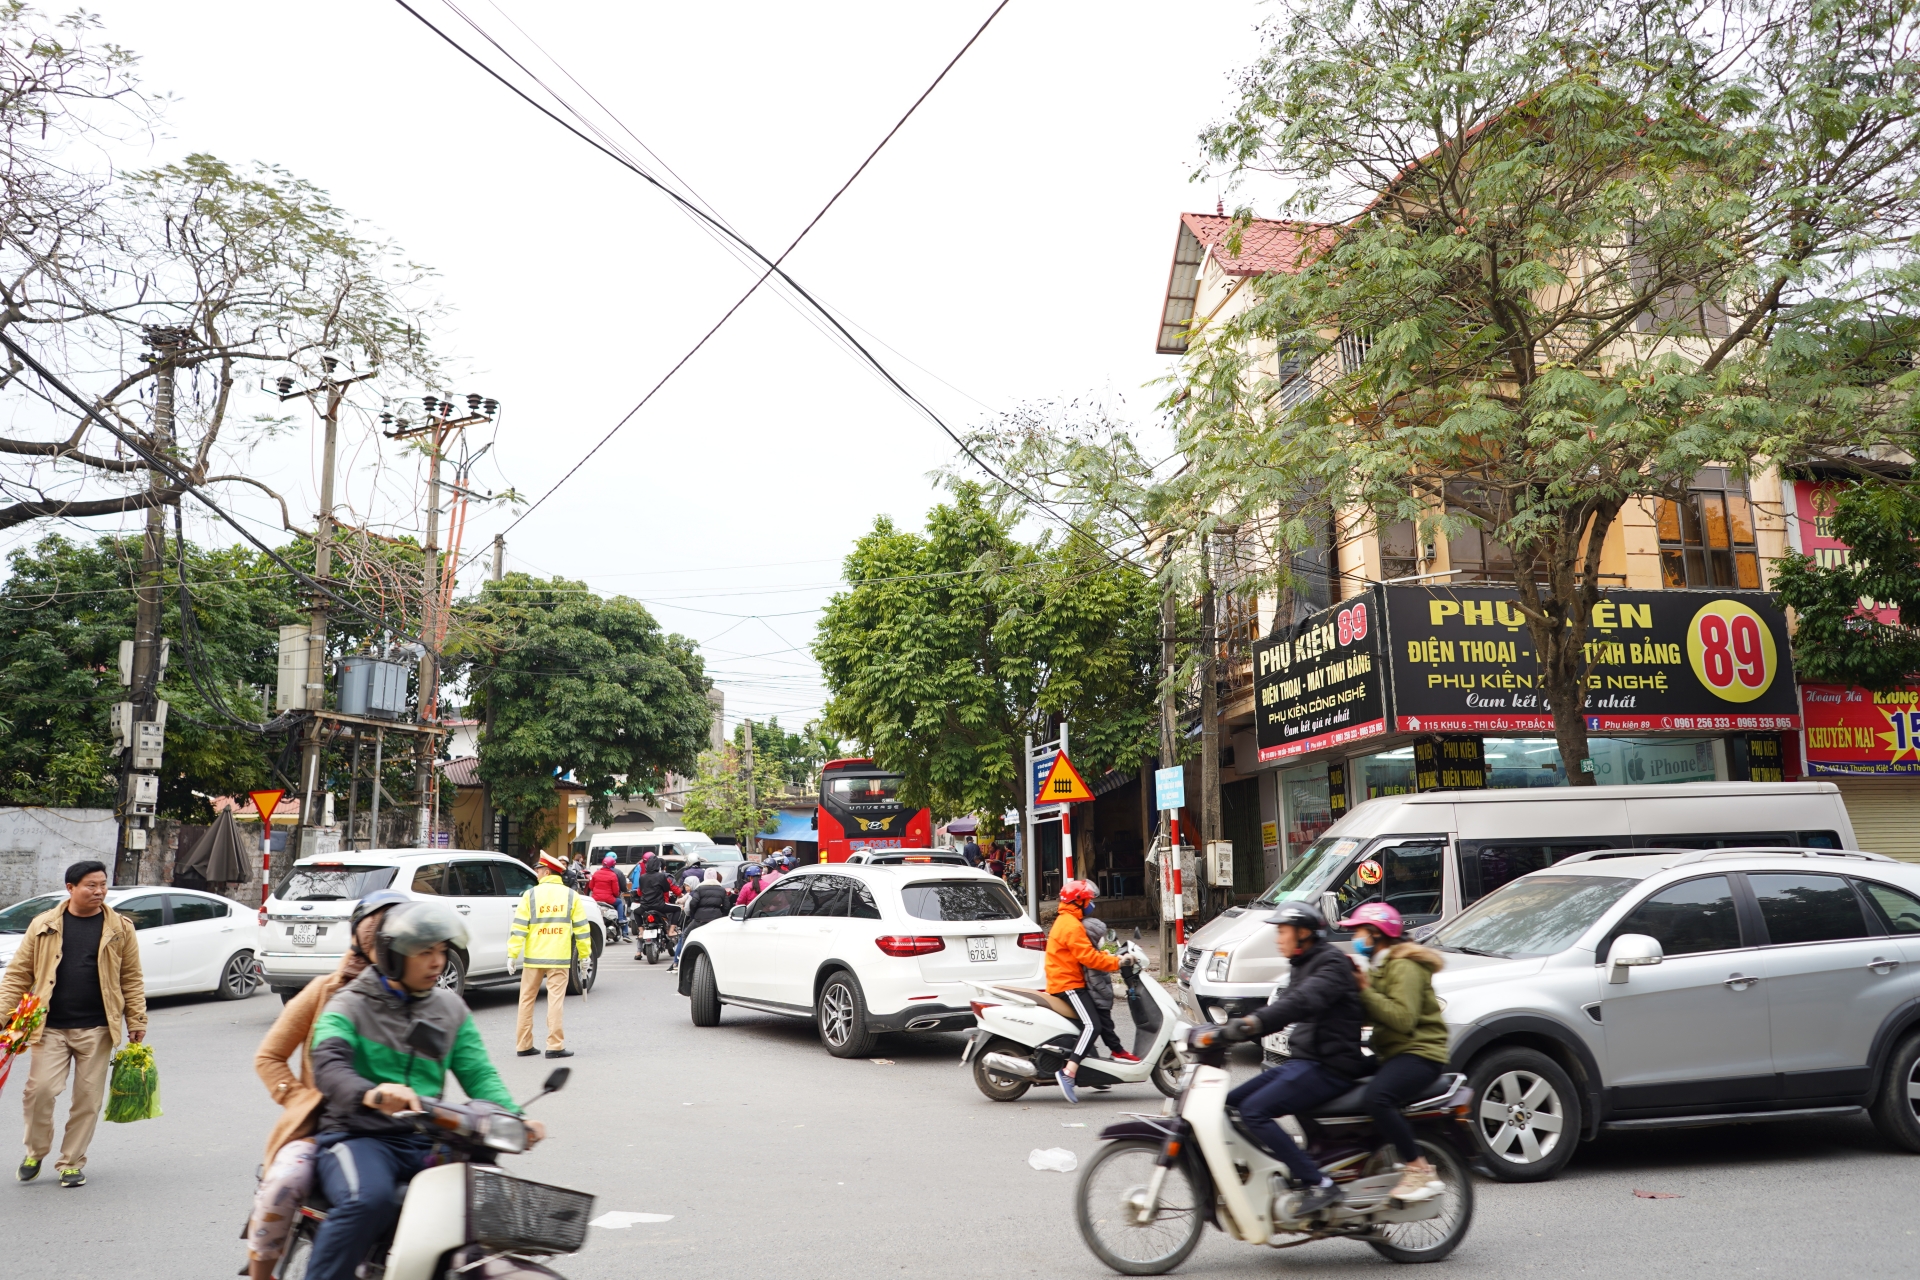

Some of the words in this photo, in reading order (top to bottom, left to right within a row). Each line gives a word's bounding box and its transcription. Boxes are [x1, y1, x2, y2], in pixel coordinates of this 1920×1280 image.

[1429, 600, 1526, 632] PHỤ
[1259, 641, 1291, 676] PHỤ
[1295, 622, 1336, 664] KIỆN
[1337, 602, 1368, 647] 89
[1408, 636, 1455, 668] ĐIỆN
[1459, 641, 1517, 668] THOẠI
[1584, 639, 1626, 665] TÍNH
[1630, 636, 1682, 665] BẢNG
[1699, 613, 1766, 689] 89
[1261, 681, 1279, 708] ĐIỆN
[1280, 676, 1302, 700] THOẠI
[1307, 666, 1325, 692] MÁY
[1325, 661, 1346, 686] TÍNH
[1346, 650, 1372, 680] BẢNG
[1427, 674, 1475, 693] PHỤ
[1481, 670, 1533, 693] KIỆN
[1607, 671, 1669, 694] NGHỆ
[1268, 710, 1287, 725] PHỤ
[1287, 703, 1308, 720] KIỆN
[1309, 694, 1336, 713] CÔNG
[1337, 681, 1366, 703] NGHỆ
[1466, 692, 1506, 708] Cam
[1512, 692, 1538, 708] kết
[1598, 694, 1637, 708] nhất
[1284, 724, 1300, 737] Cam
[1300, 719, 1311, 733] kết
[1311, 718, 1324, 733] giá
[1333, 708, 1350, 724] nhất
[1424, 721, 1438, 730] 115
[1440, 721, 1459, 729] KHU
[1461, 721, 1467, 729] 6
[1473, 721, 1488, 730] THỊ
[1490, 718, 1508, 729] CẦU
[1515, 717, 1546, 729] TP.BẮC
[1641, 721, 1650, 729] 89
[1674, 717, 1694, 728] 0961
[1697, 717, 1713, 728] 256
[1714, 717, 1730, 728] 333
[1737, 717, 1757, 728] 0965
[1759, 717, 1774, 728] 335
[1776, 717, 1791, 728] 865
[1808, 717, 1852, 749] KHUYẾN
[1854, 726, 1875, 754] MẠI
[1443, 742, 1458, 762] PHỤ
[1460, 738, 1478, 762] KIỆN
[1751, 740, 1763, 760] PHỤ
[1764, 737, 1777, 760] KIỆN
[1442, 766, 1460, 791] ĐIỆN
[1461, 770, 1483, 790] THOẠI
[1650, 758, 1696, 777] iPhone
[1876, 764, 1888, 773] Kiệt
[1893, 763, 1906, 772] Khu
[1907, 764, 1911, 772] 6
[299, 924, 311, 934] 30F
[537, 927, 563, 936] POLICE
[970, 949, 997, 960] 678.45
[973, 938, 989, 949] 30E
